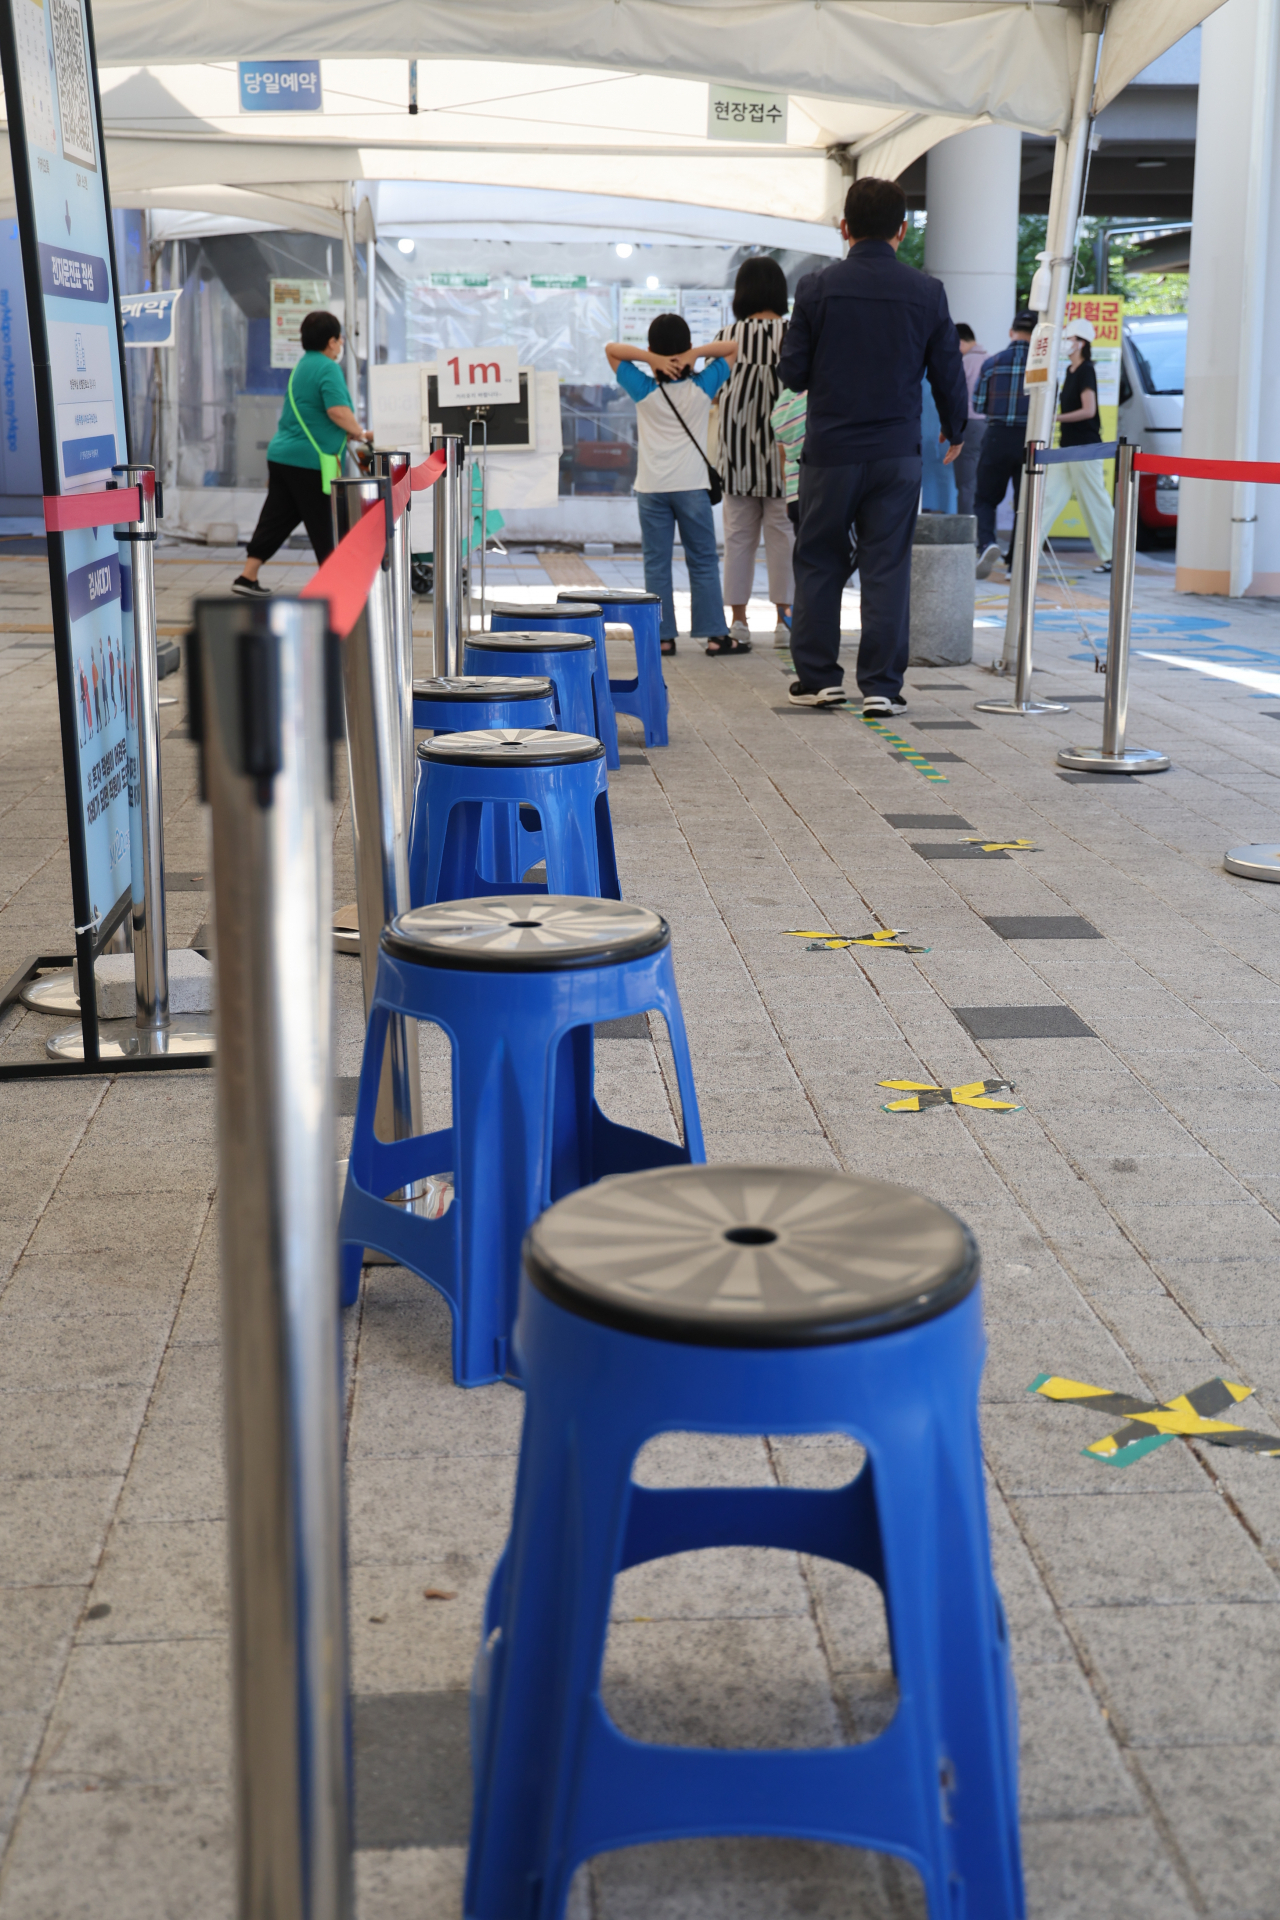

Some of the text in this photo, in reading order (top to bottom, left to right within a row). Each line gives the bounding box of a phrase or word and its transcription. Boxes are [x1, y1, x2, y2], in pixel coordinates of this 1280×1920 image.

[243, 72, 318, 94] 당일예약
[714, 100, 783, 124] 현장접수
[51, 256, 95, 292] 전자문진표 작성
[447, 356, 501, 386] 1m
[88, 564, 112, 600] 검사대기
